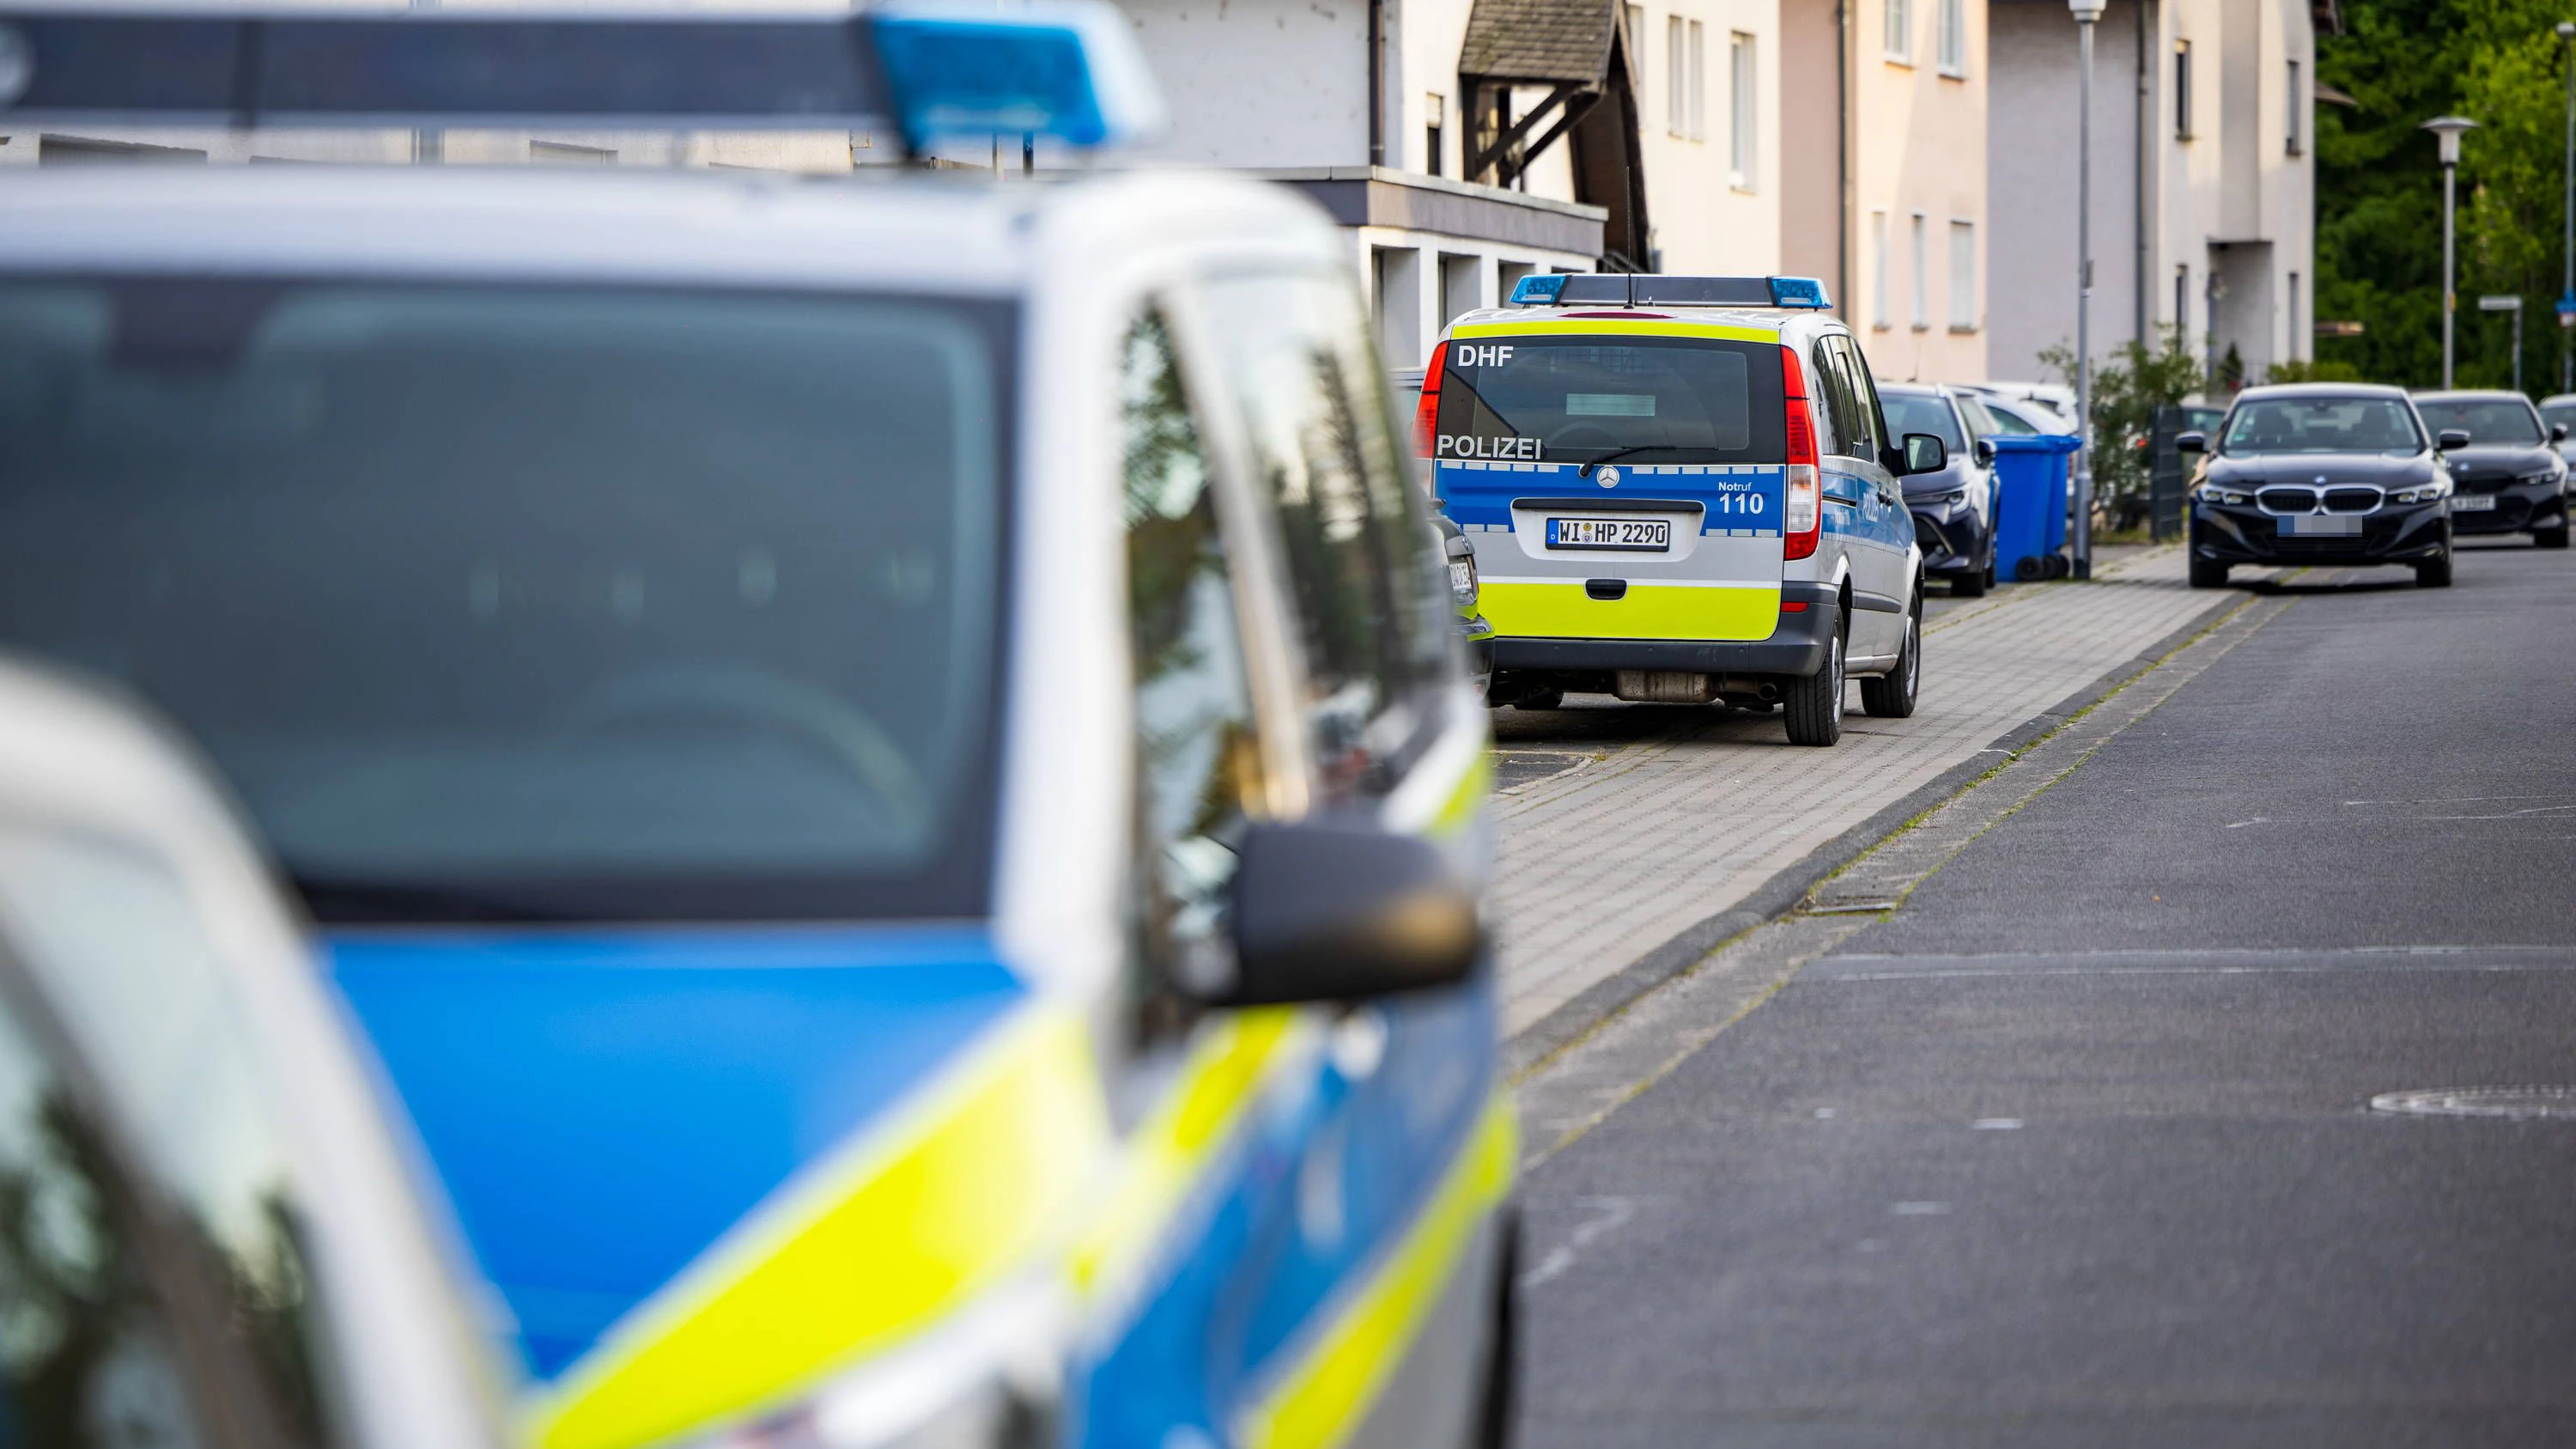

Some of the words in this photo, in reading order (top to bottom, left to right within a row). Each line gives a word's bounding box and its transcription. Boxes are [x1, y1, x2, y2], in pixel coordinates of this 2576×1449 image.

[1457, 345, 1514, 367] DHF
[1437, 435, 1541, 460] POLIZEI
[1718, 482, 1753, 491] Notruf
[1719, 493, 1764, 514] 110
[1559, 522, 1580, 542] WI
[1595, 523, 1618, 543] HP
[1622, 524, 1666, 544] 2290
